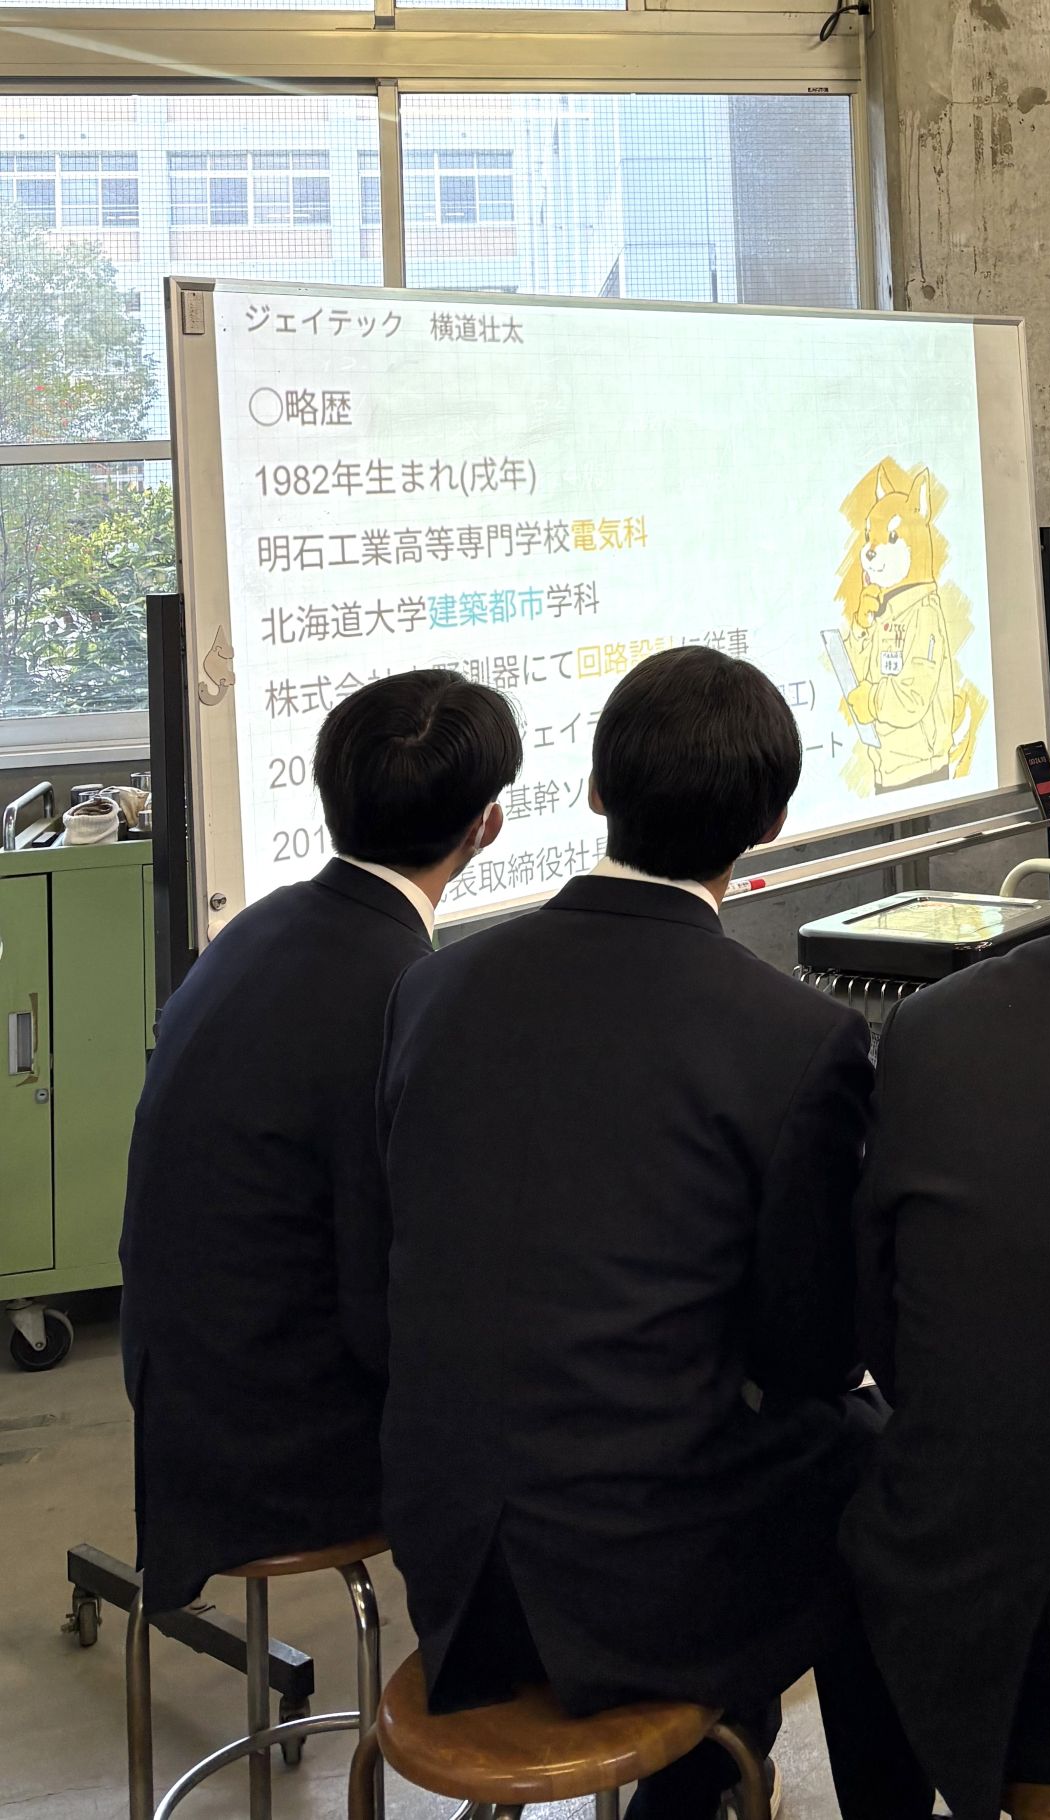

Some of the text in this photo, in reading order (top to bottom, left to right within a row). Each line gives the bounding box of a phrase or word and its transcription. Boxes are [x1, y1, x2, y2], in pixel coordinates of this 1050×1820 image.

[245, 304, 524, 344] ジェイテック 横道壮太
[254, 457, 537, 497] 1982年生まれ(戌年)
[257, 515, 648, 573] 明石工業高等専門学校電気科
[261, 580, 600, 646] 北海道大学建築都市学科
